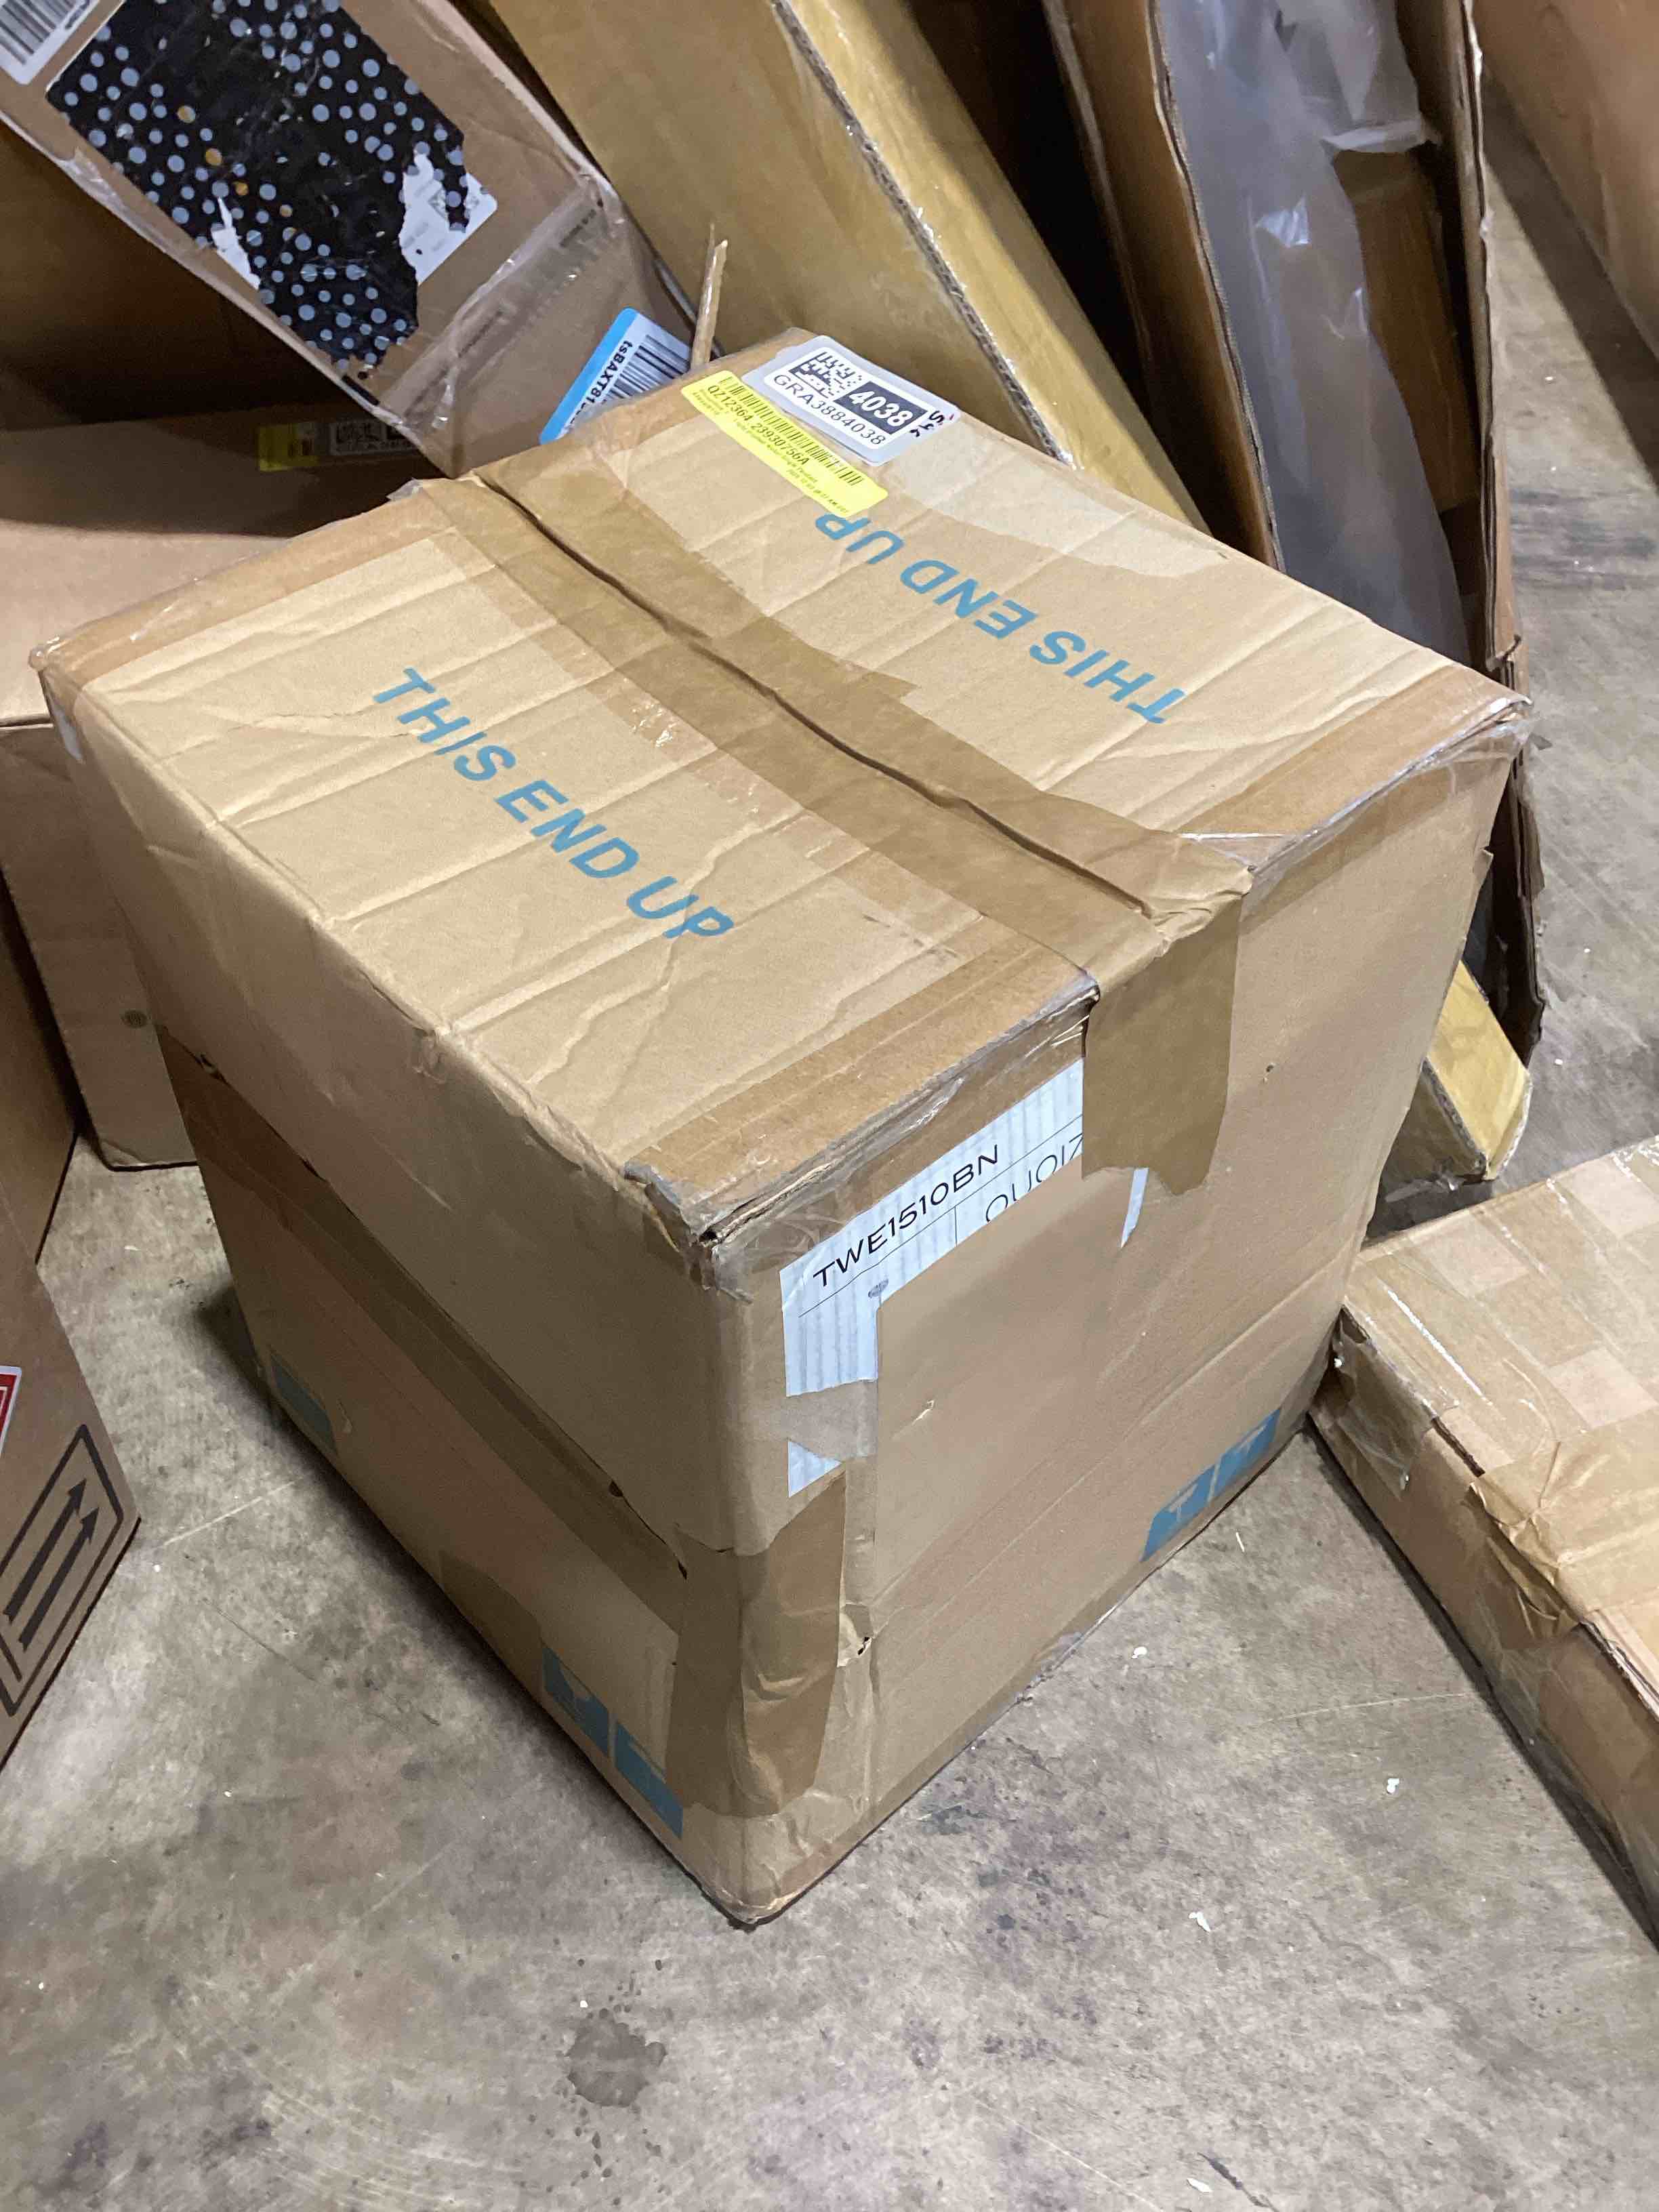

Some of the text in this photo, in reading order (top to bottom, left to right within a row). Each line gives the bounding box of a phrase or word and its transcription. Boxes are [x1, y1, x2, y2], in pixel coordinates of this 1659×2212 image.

[570, 340, 634, 424] tsBAXT81
[773, 374, 886, 445] GRA3884038
[848, 389, 912, 428] 4038
[815, 513, 1186, 724] THIS END UP
[373, 667, 735, 939] THIS END UP
[813, 1144, 998, 1287] TWE1510BN
